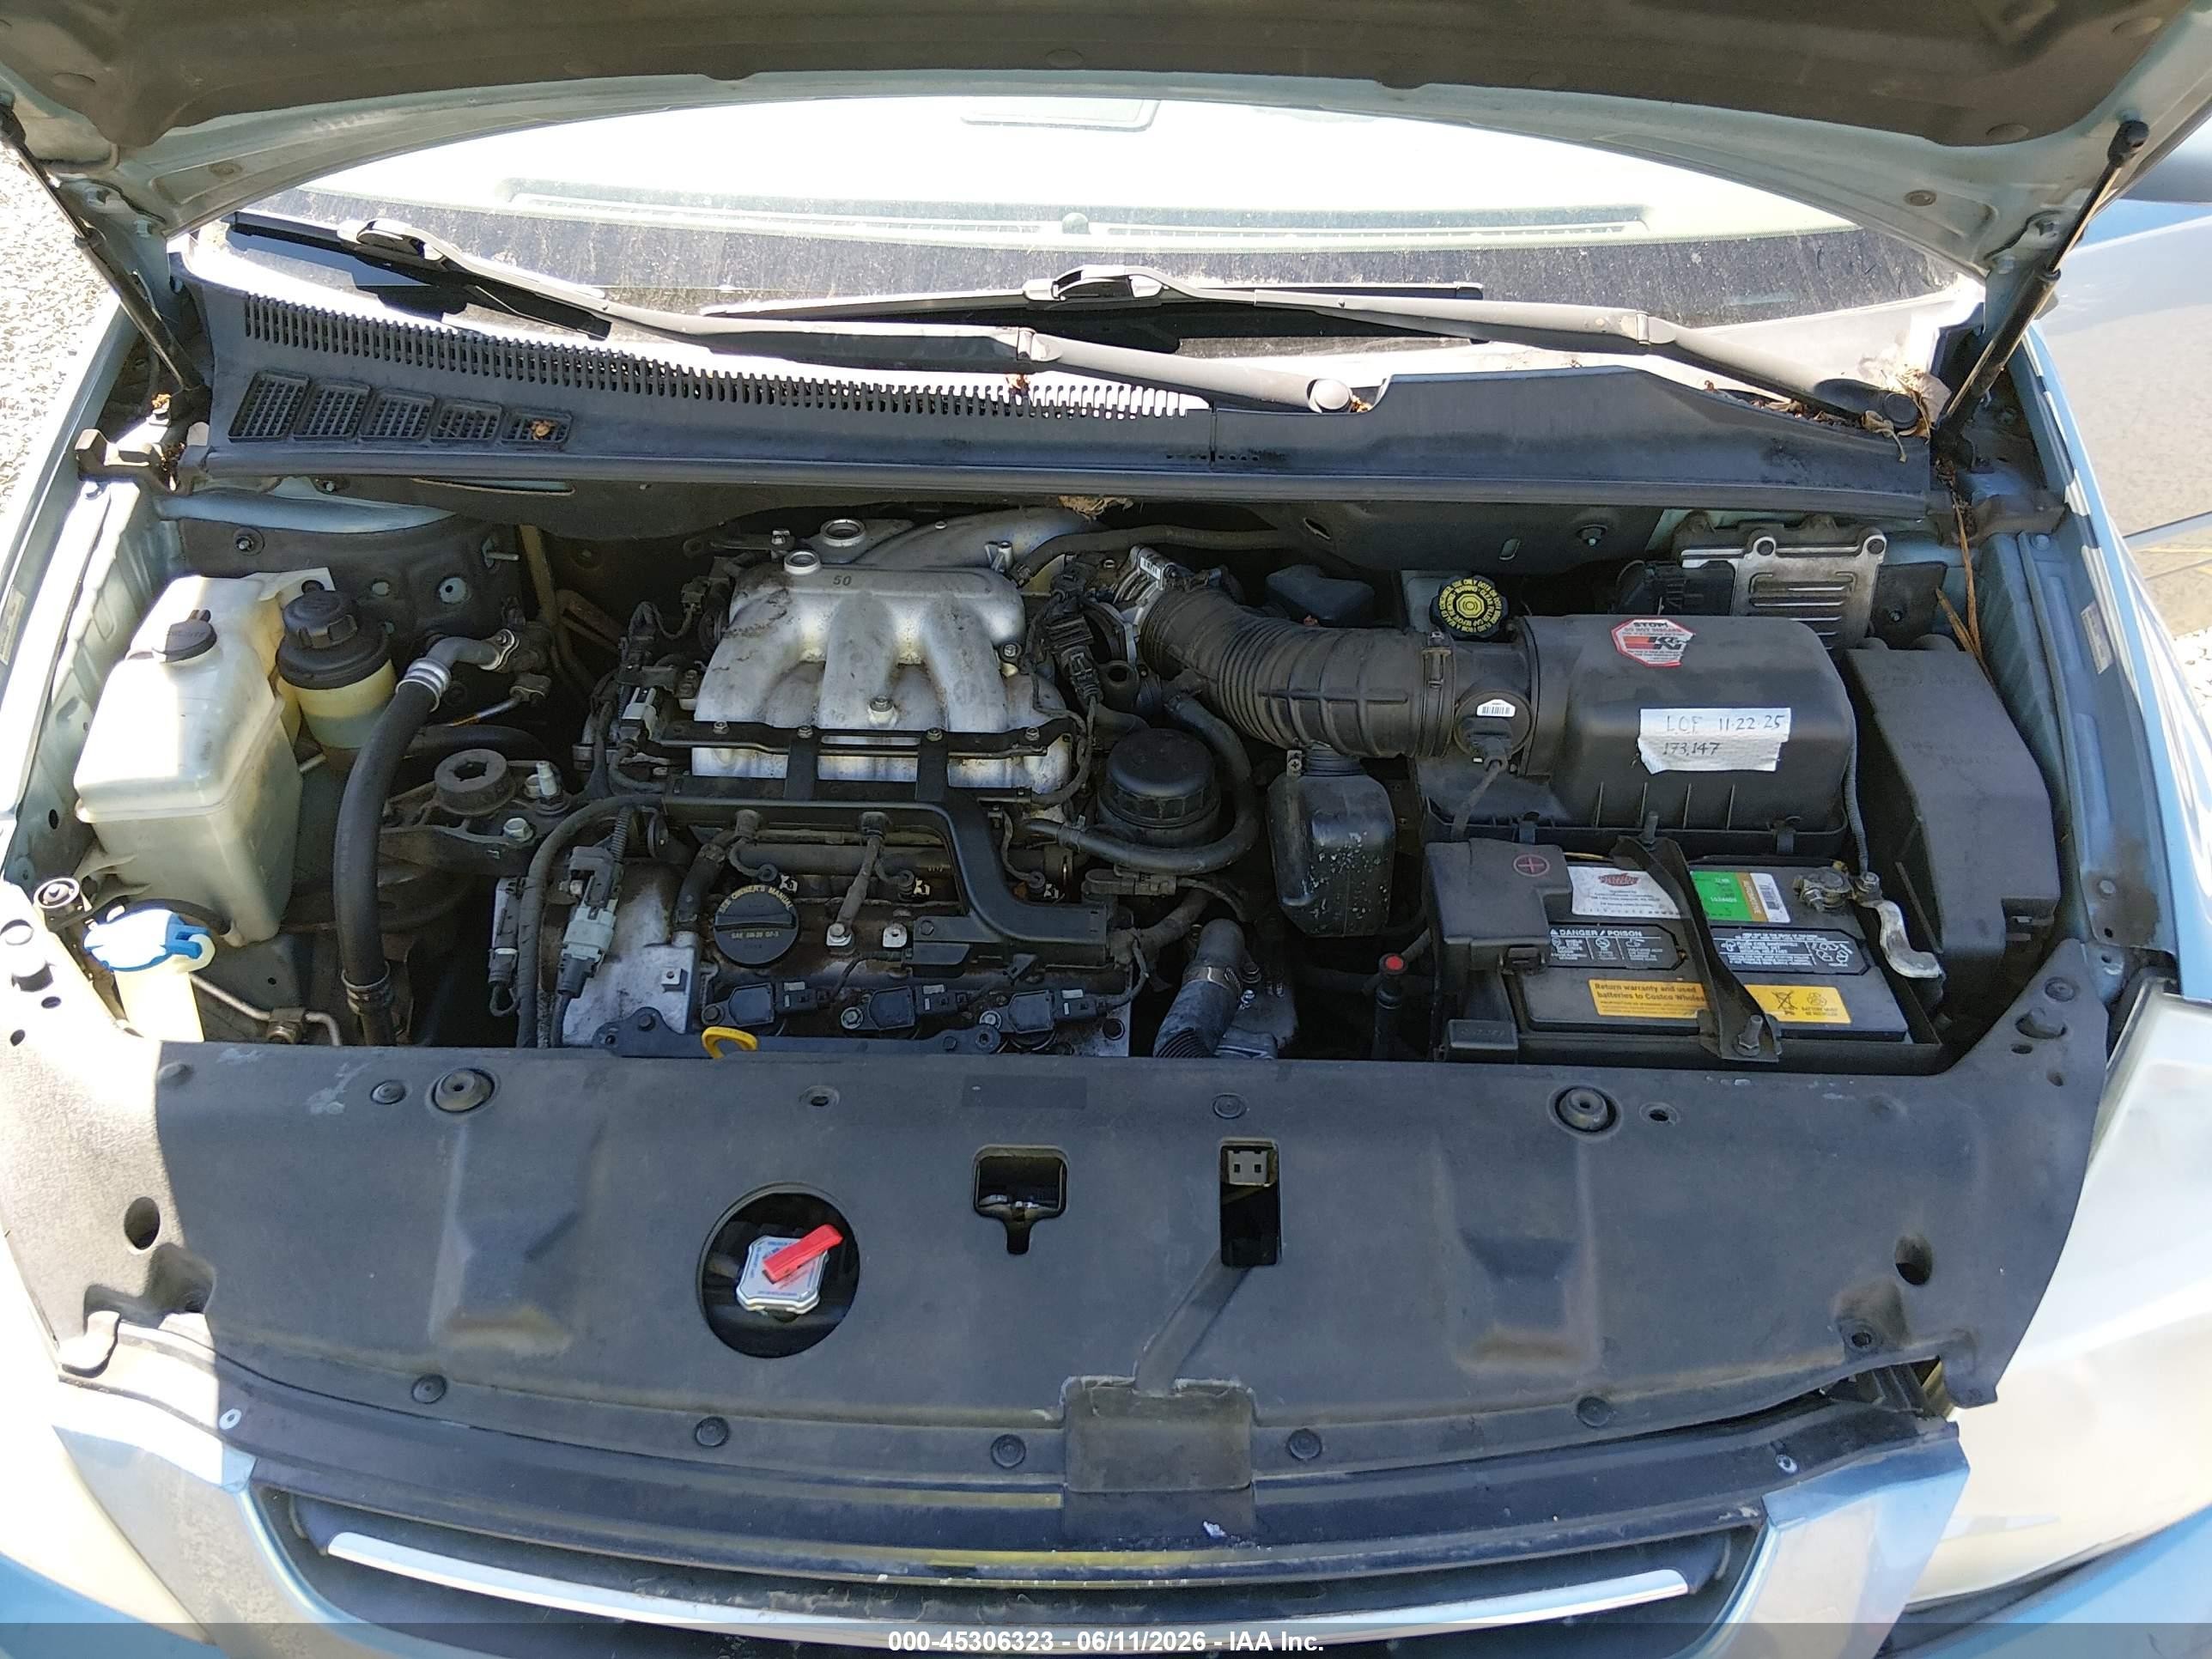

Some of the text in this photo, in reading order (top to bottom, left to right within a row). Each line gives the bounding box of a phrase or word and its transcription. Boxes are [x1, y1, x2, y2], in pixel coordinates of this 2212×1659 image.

[833, 575, 852, 586] 50
[768, 886, 794, 911] MANUAL
[1624, 984, 1658, 993] warranty
[1596, 991, 1633, 1000] batteries
